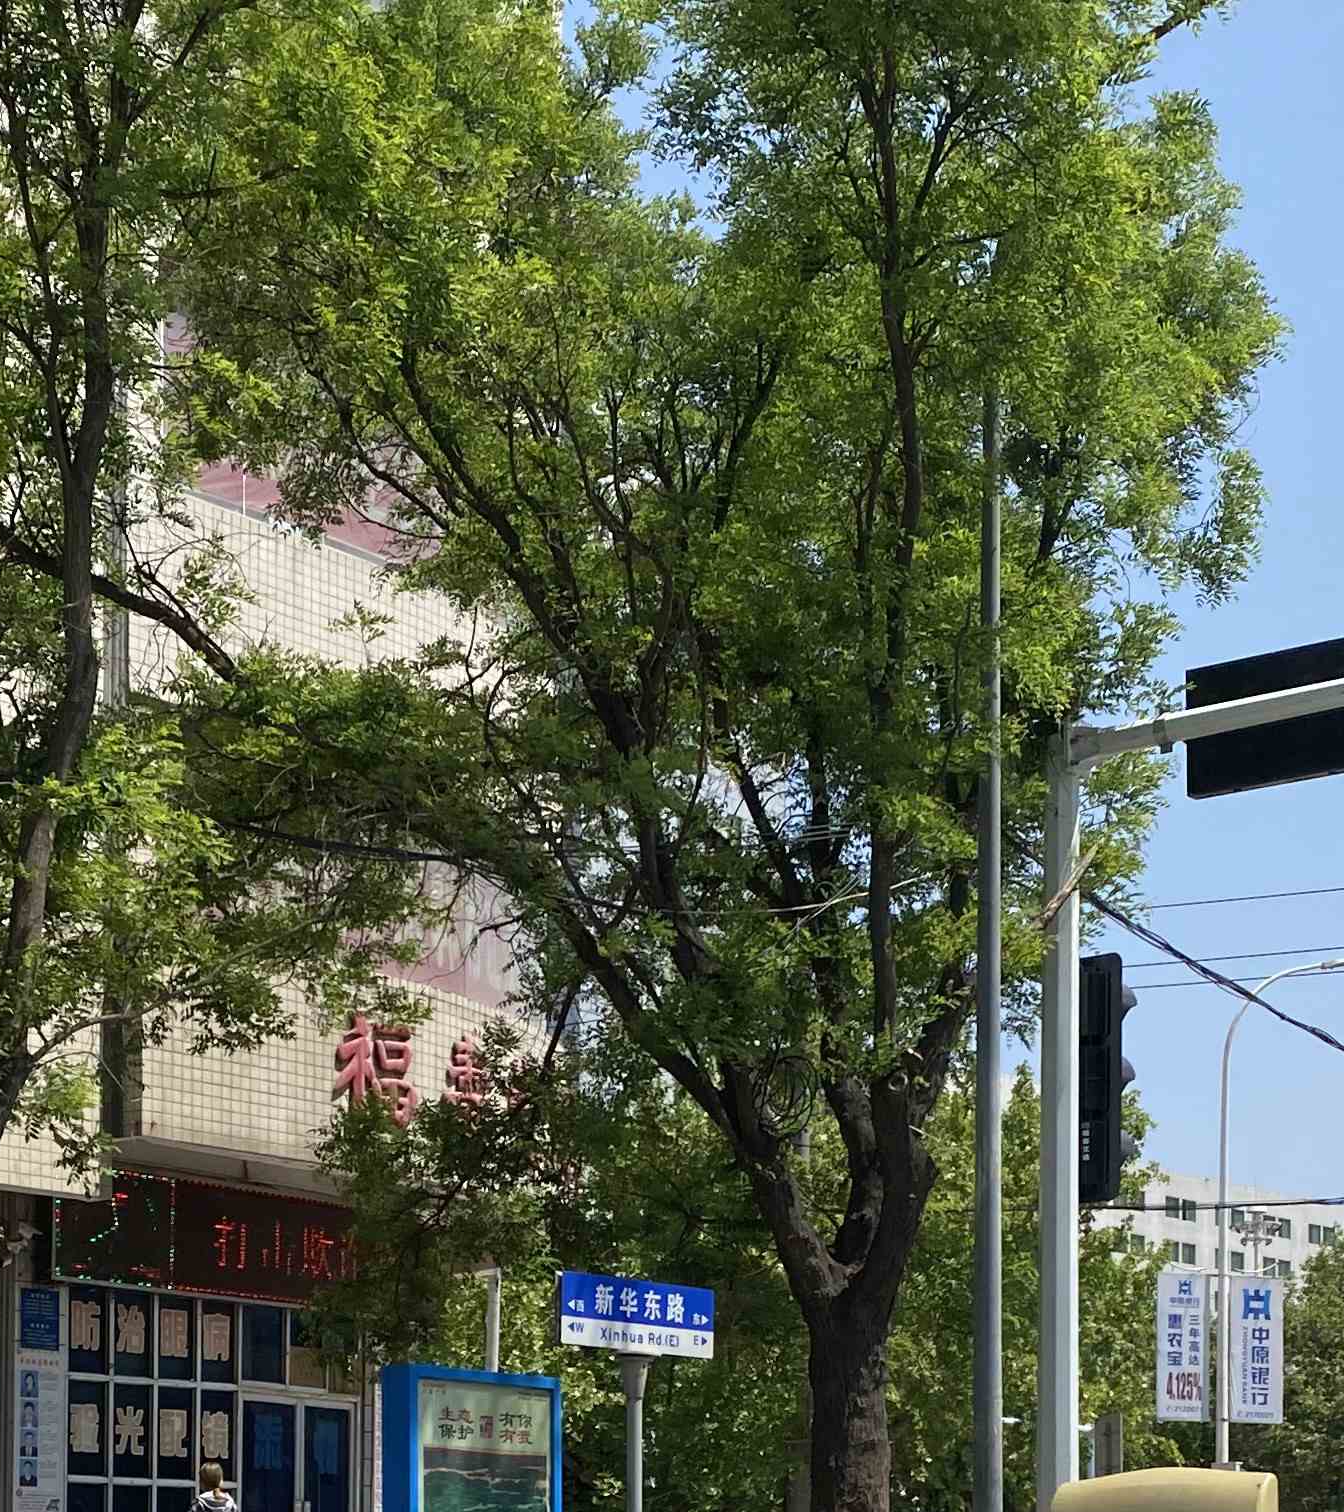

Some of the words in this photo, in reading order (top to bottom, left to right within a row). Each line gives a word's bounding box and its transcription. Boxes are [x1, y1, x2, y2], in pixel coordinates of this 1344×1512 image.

[595, 1283, 685, 1325] 新华东路
[600, 1327, 644, 1345] Xinhua
[1250, 1326, 1271, 1406] 中原银行
